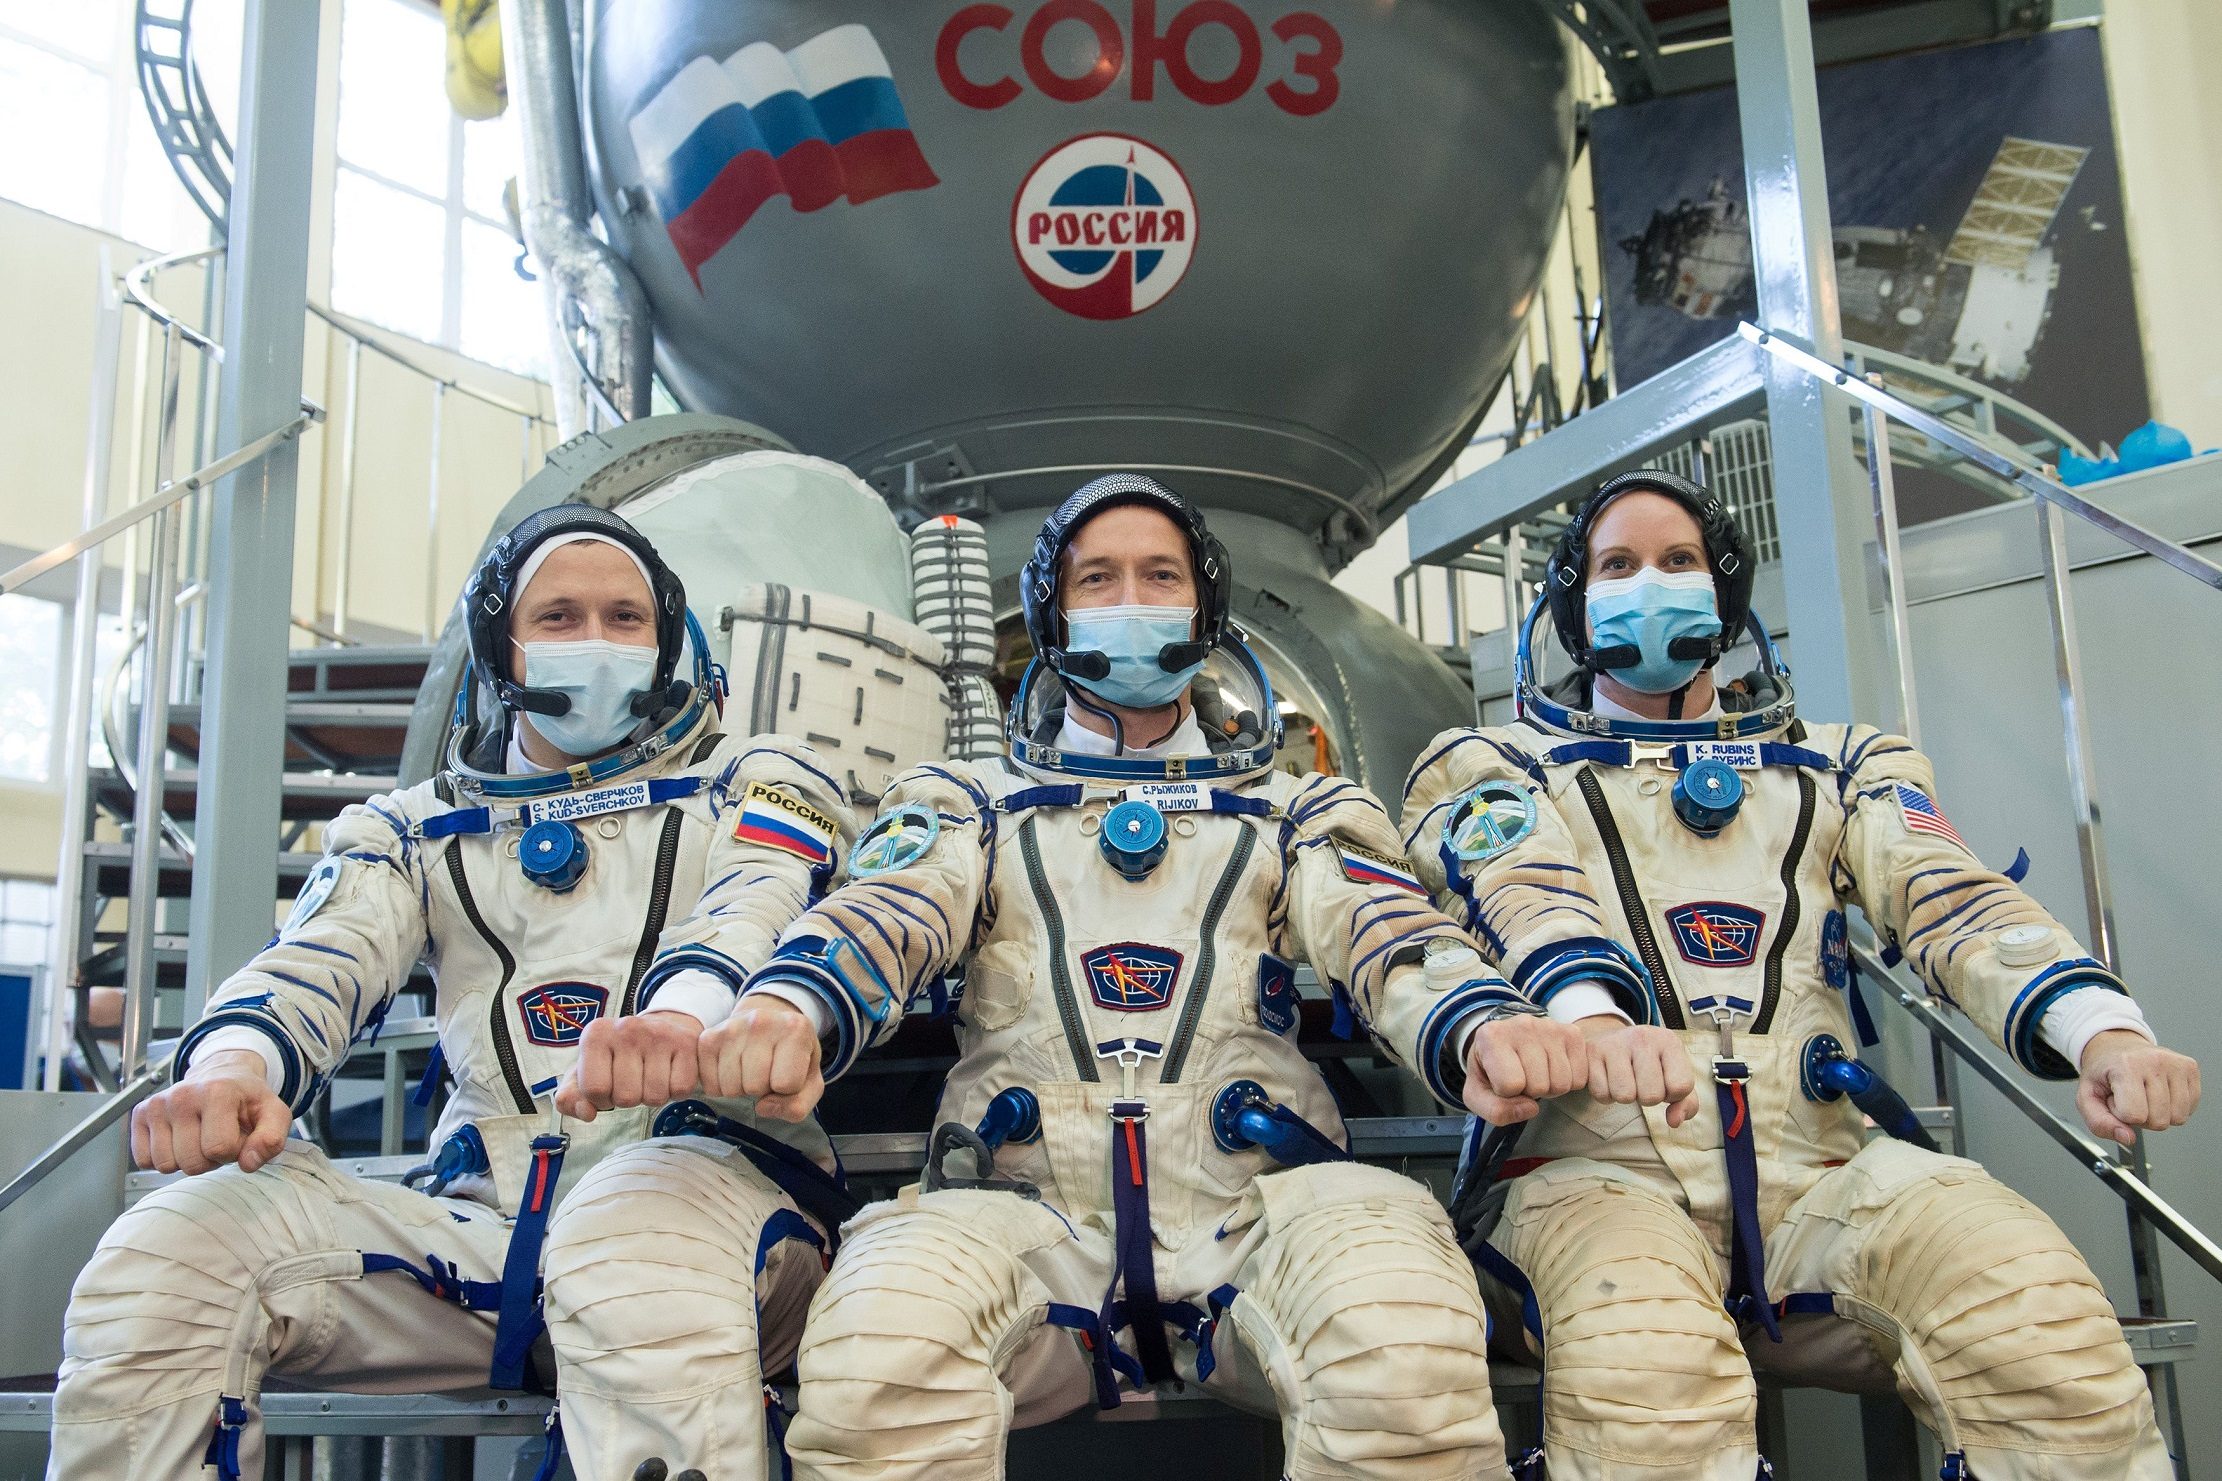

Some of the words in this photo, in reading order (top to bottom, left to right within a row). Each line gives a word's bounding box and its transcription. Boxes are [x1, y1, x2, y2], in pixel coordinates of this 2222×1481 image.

[935, 0, 1344, 117] СОЮЗ
[1028, 210, 1185, 245] РОССИЯ
[1695, 744, 1708, 754] K.
[1711, 744, 1755, 755] RUBINS
[532, 803, 545, 813] С.
[548, 785, 645, 810] КУДЬ-СВЕРЧКОВ
[548, 795, 645, 821] KUD-SVERCHKOV
[751, 785, 835, 835] РОССИЯ
[1157, 799, 1199, 810] RIJIKOV
[1337, 840, 1412, 873] РОССИЯ
